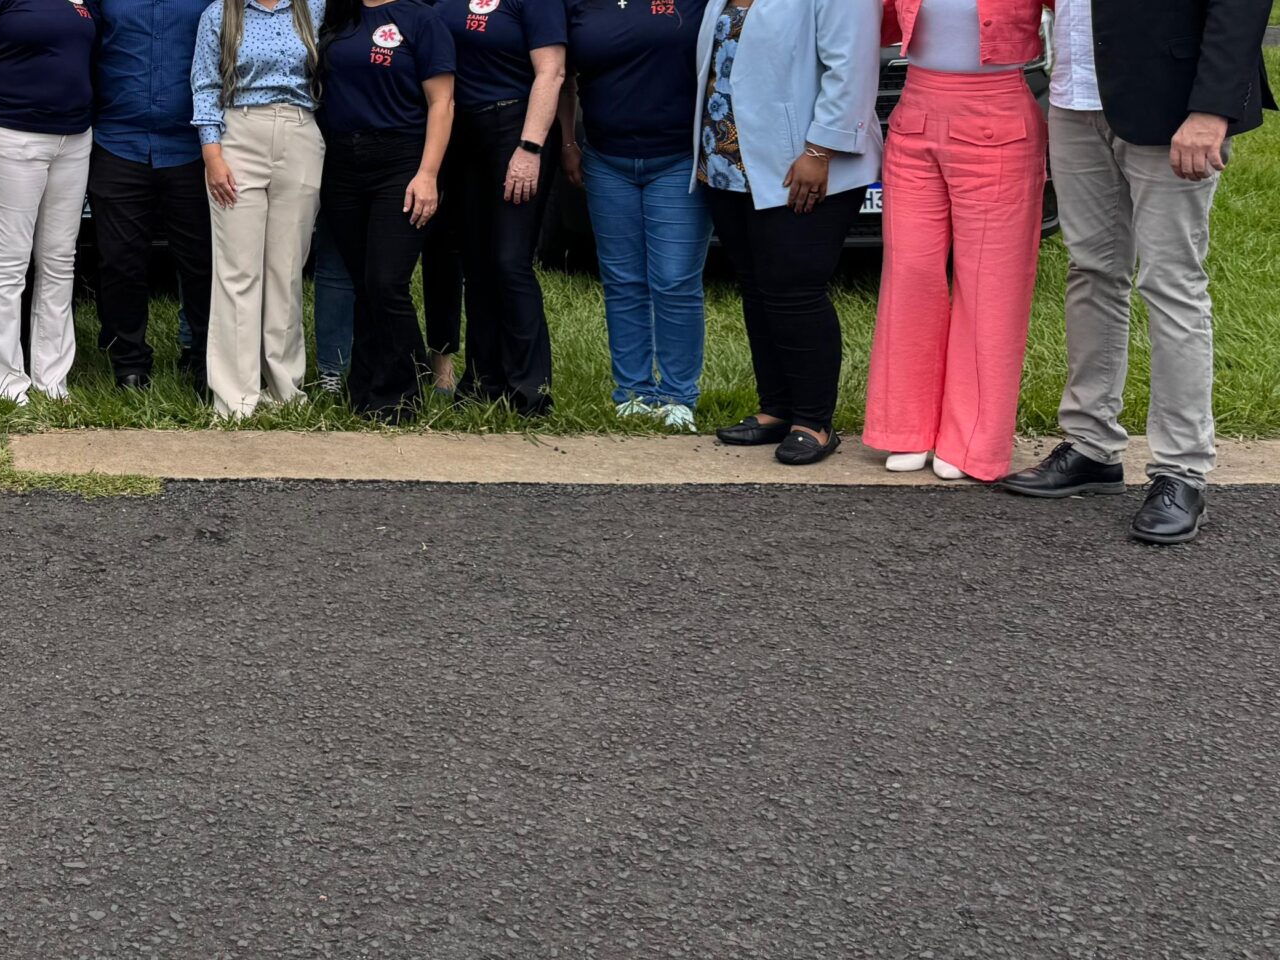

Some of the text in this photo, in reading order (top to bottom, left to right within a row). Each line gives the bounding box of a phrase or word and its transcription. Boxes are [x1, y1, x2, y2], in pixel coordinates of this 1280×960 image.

[651, 5, 675, 15] 192
[466, 20, 487, 32] 192
[371, 46, 394, 56] SAMU
[370, 53, 392, 66] 192
